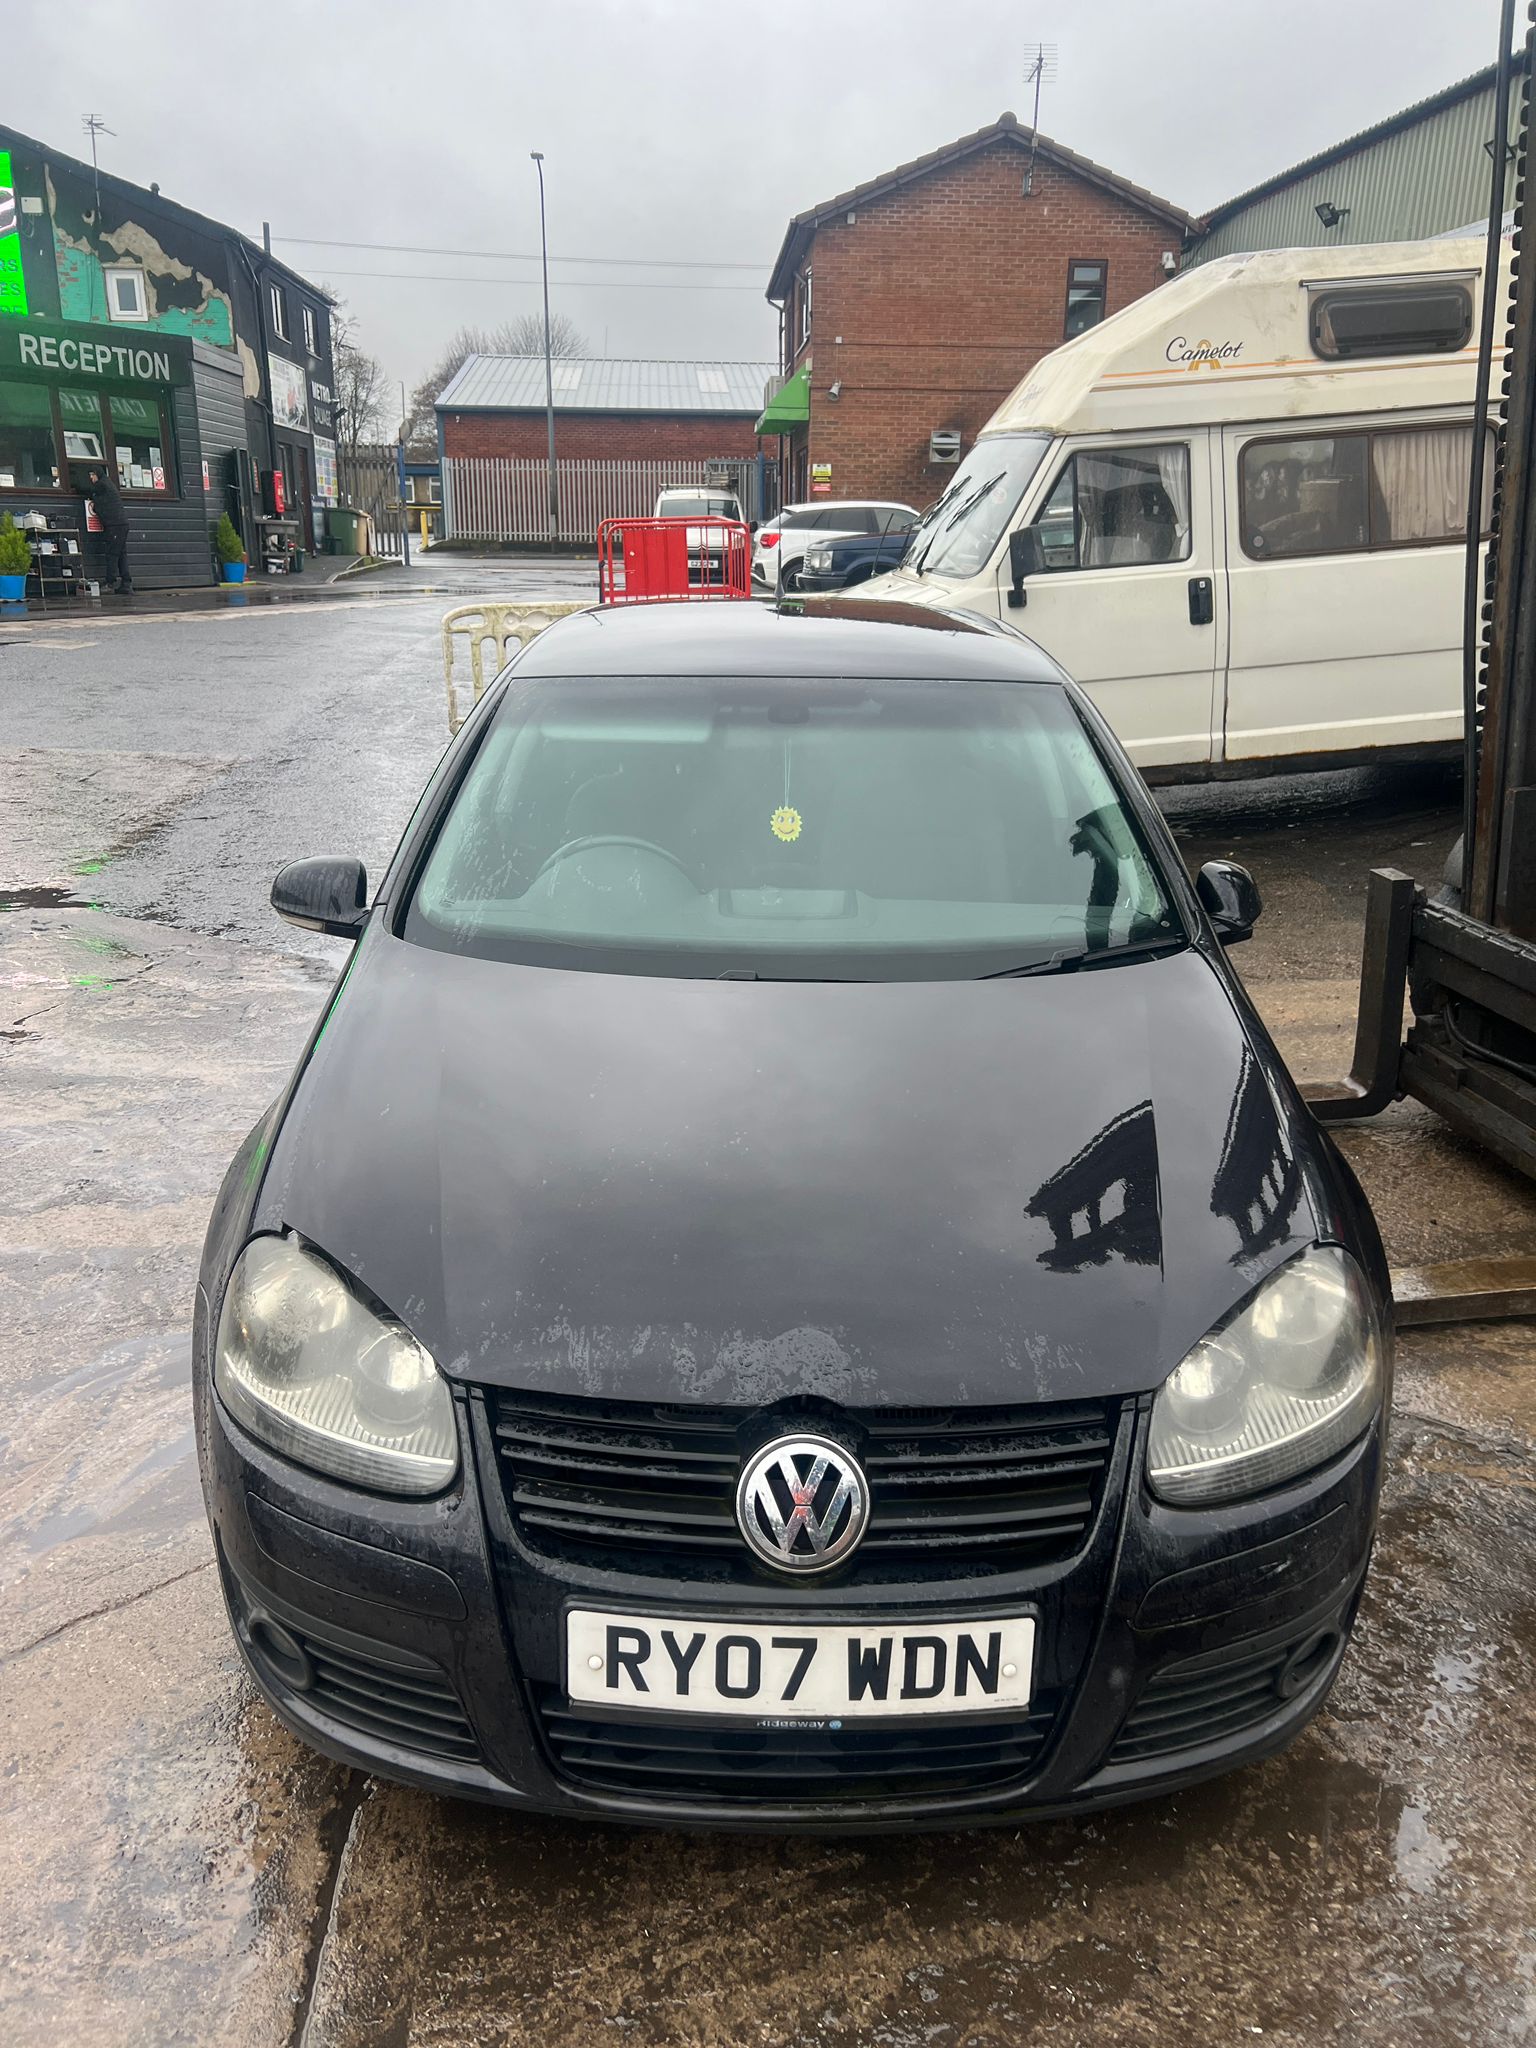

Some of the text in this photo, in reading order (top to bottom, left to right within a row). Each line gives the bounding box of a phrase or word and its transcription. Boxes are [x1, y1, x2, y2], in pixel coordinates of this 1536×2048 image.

[18, 333, 171, 381] RECEPTION
[1166, 336, 1245, 362] Camelot
[605, 1624, 1003, 1702] RY07 WDN
